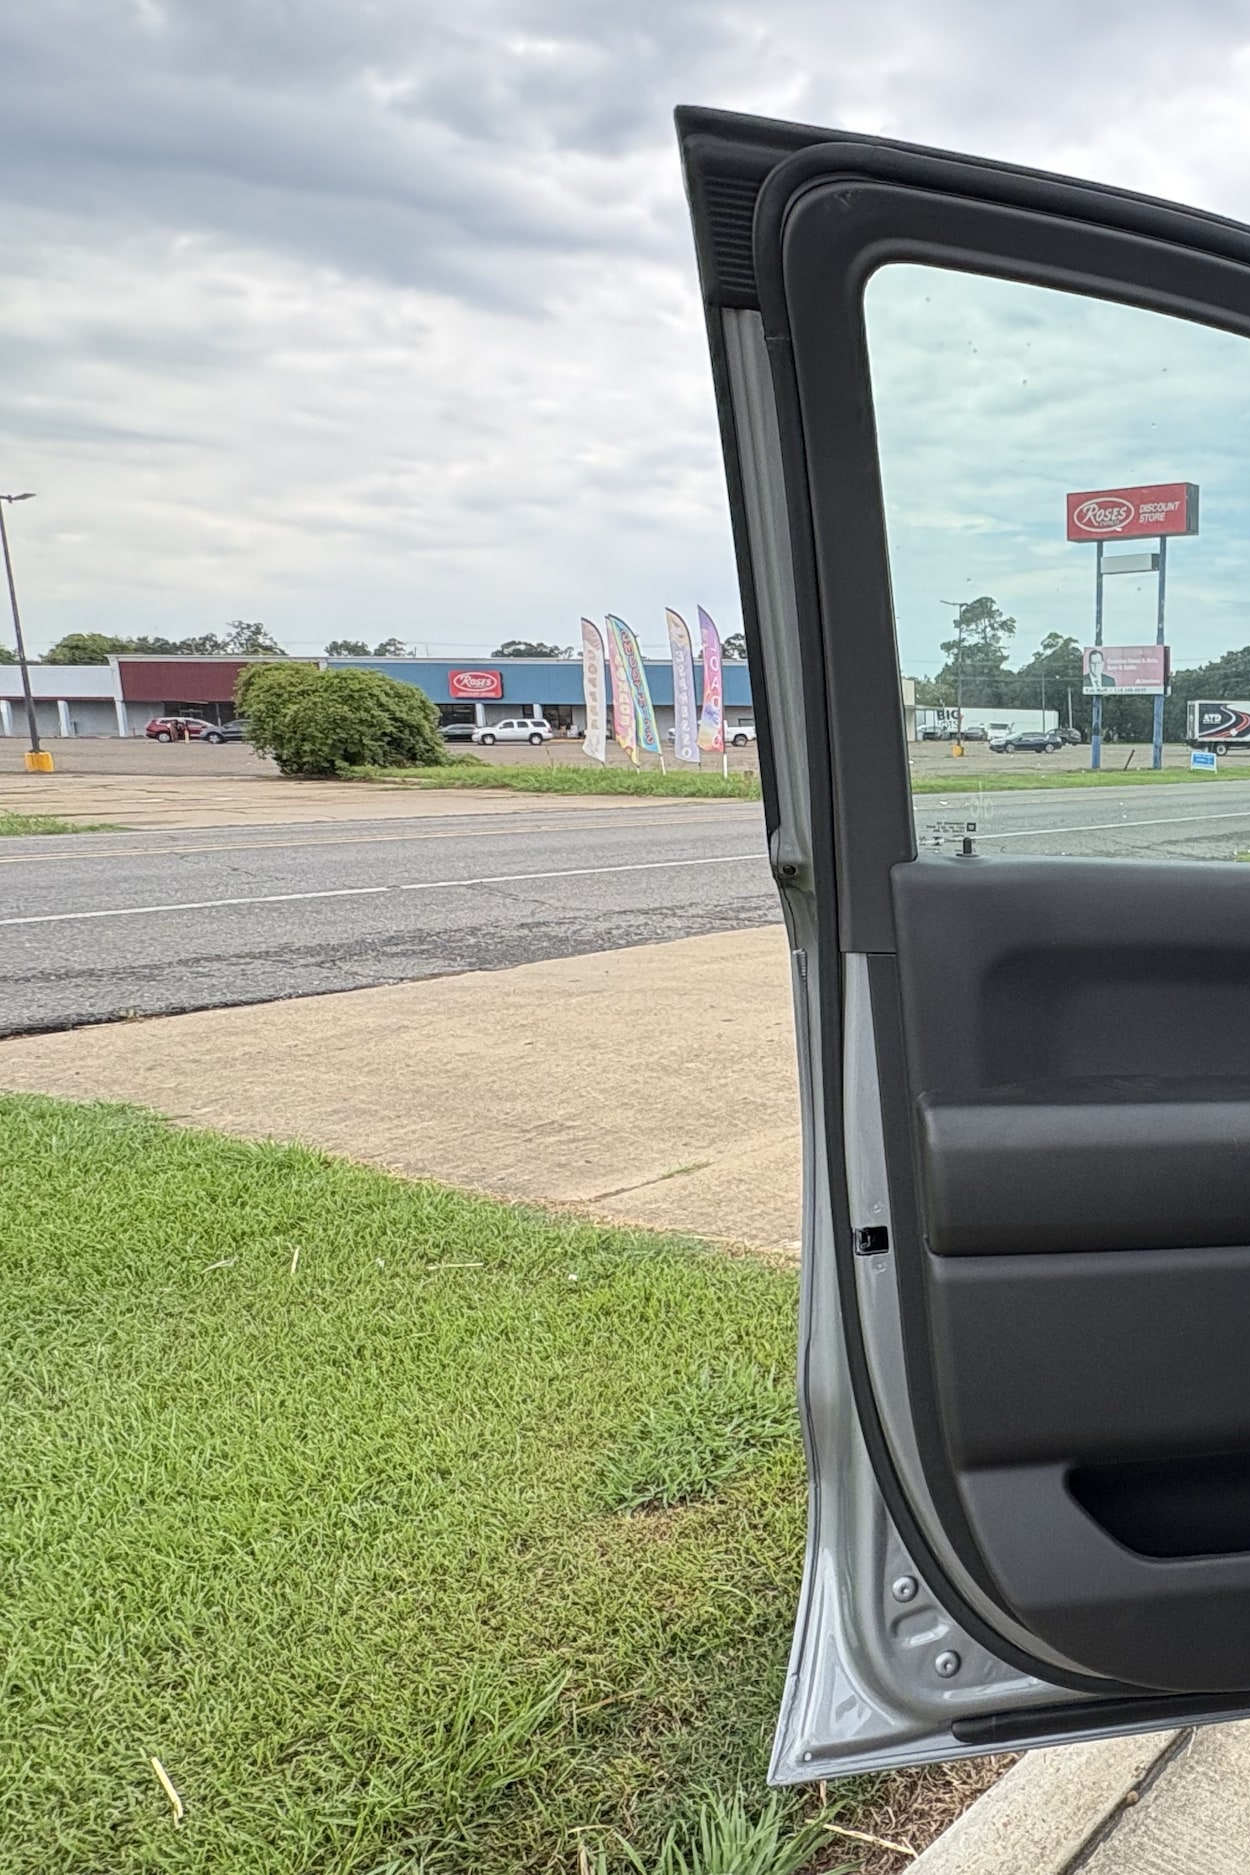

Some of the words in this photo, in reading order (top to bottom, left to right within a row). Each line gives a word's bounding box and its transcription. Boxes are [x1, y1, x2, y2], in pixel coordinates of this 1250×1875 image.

[1139, 500, 1182, 514] DISCOUNT
[1081, 503, 1128, 526] ROSES
[1138, 511, 1165, 524] STORE
